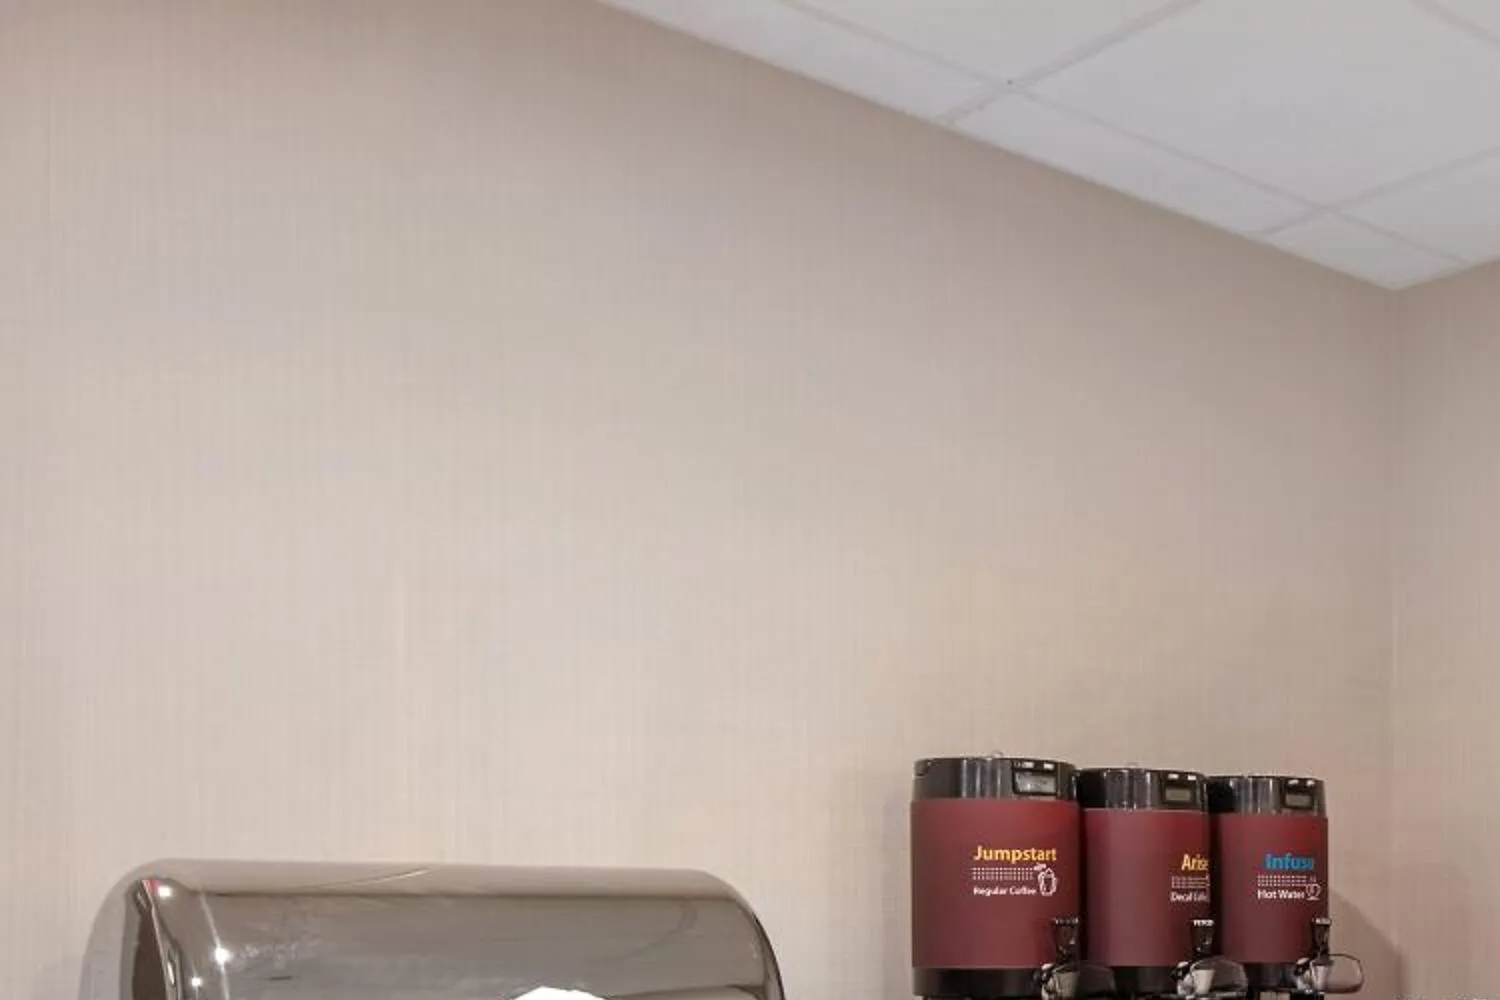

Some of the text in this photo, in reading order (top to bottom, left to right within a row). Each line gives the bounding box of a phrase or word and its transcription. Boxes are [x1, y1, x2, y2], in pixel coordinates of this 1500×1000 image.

[972, 845, 1057, 864] Jumpstart
[1257, 889, 1305, 900] Hot Water
